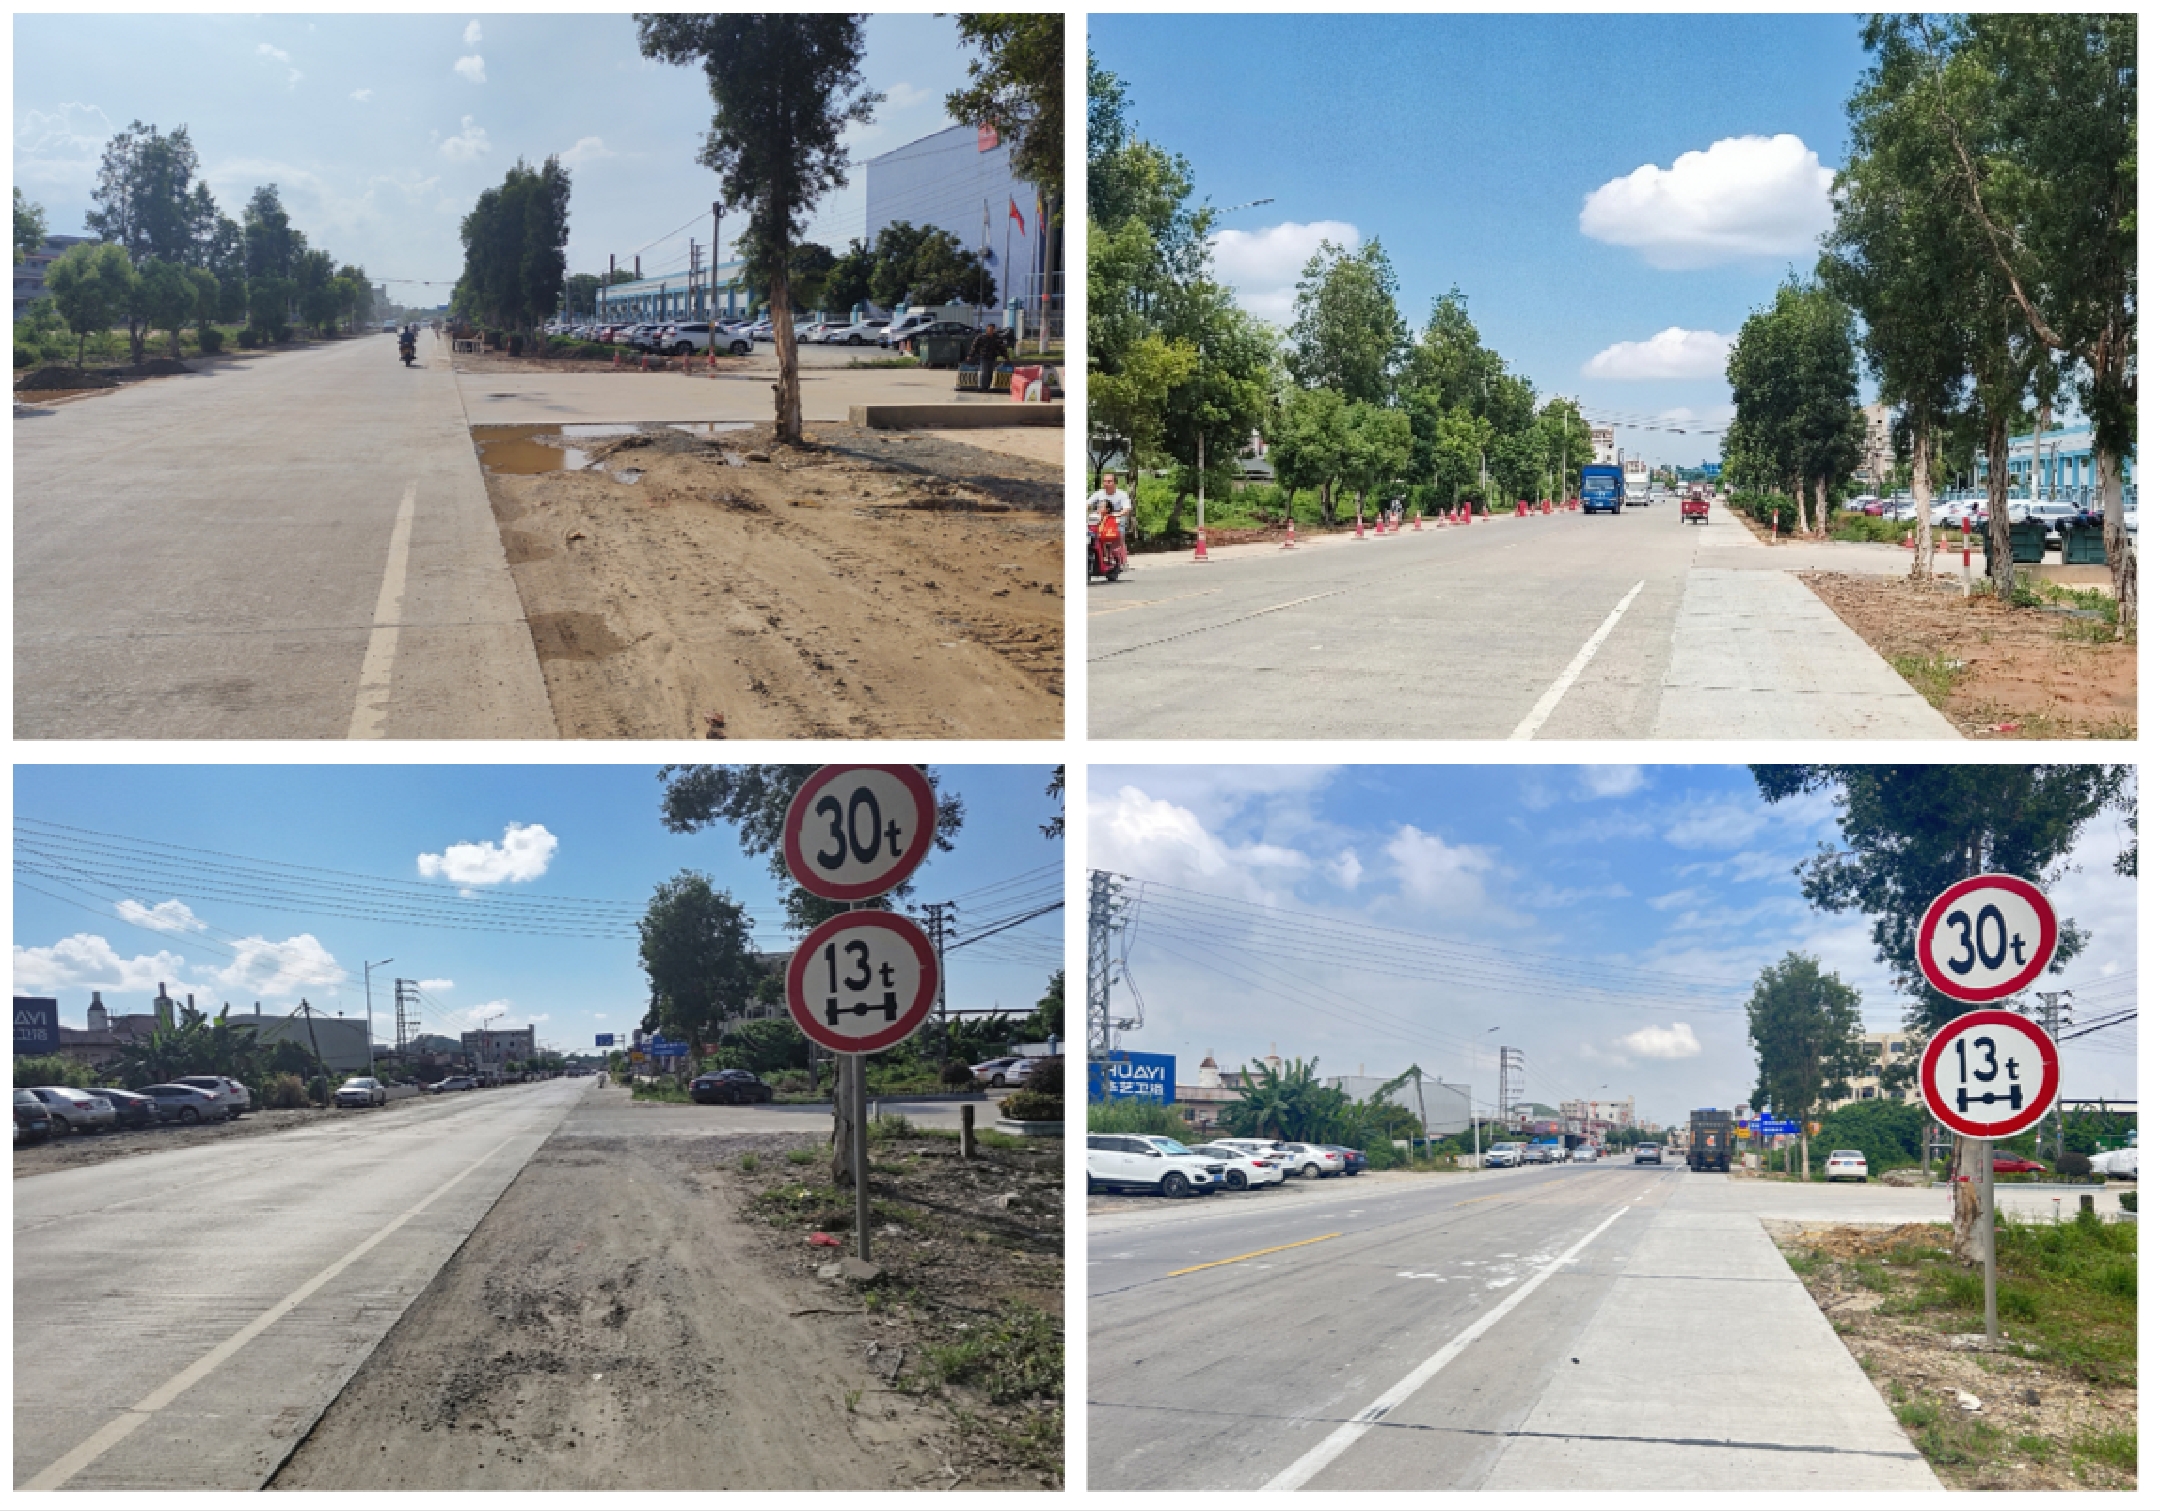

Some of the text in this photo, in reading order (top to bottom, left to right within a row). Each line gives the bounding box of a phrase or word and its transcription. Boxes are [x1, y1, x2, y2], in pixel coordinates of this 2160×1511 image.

[815, 786, 902, 870] 30t
[824, 939, 895, 994] 13t
[1946, 903, 2026, 975] 30t
[1956, 1036, 2020, 1083] 13t
